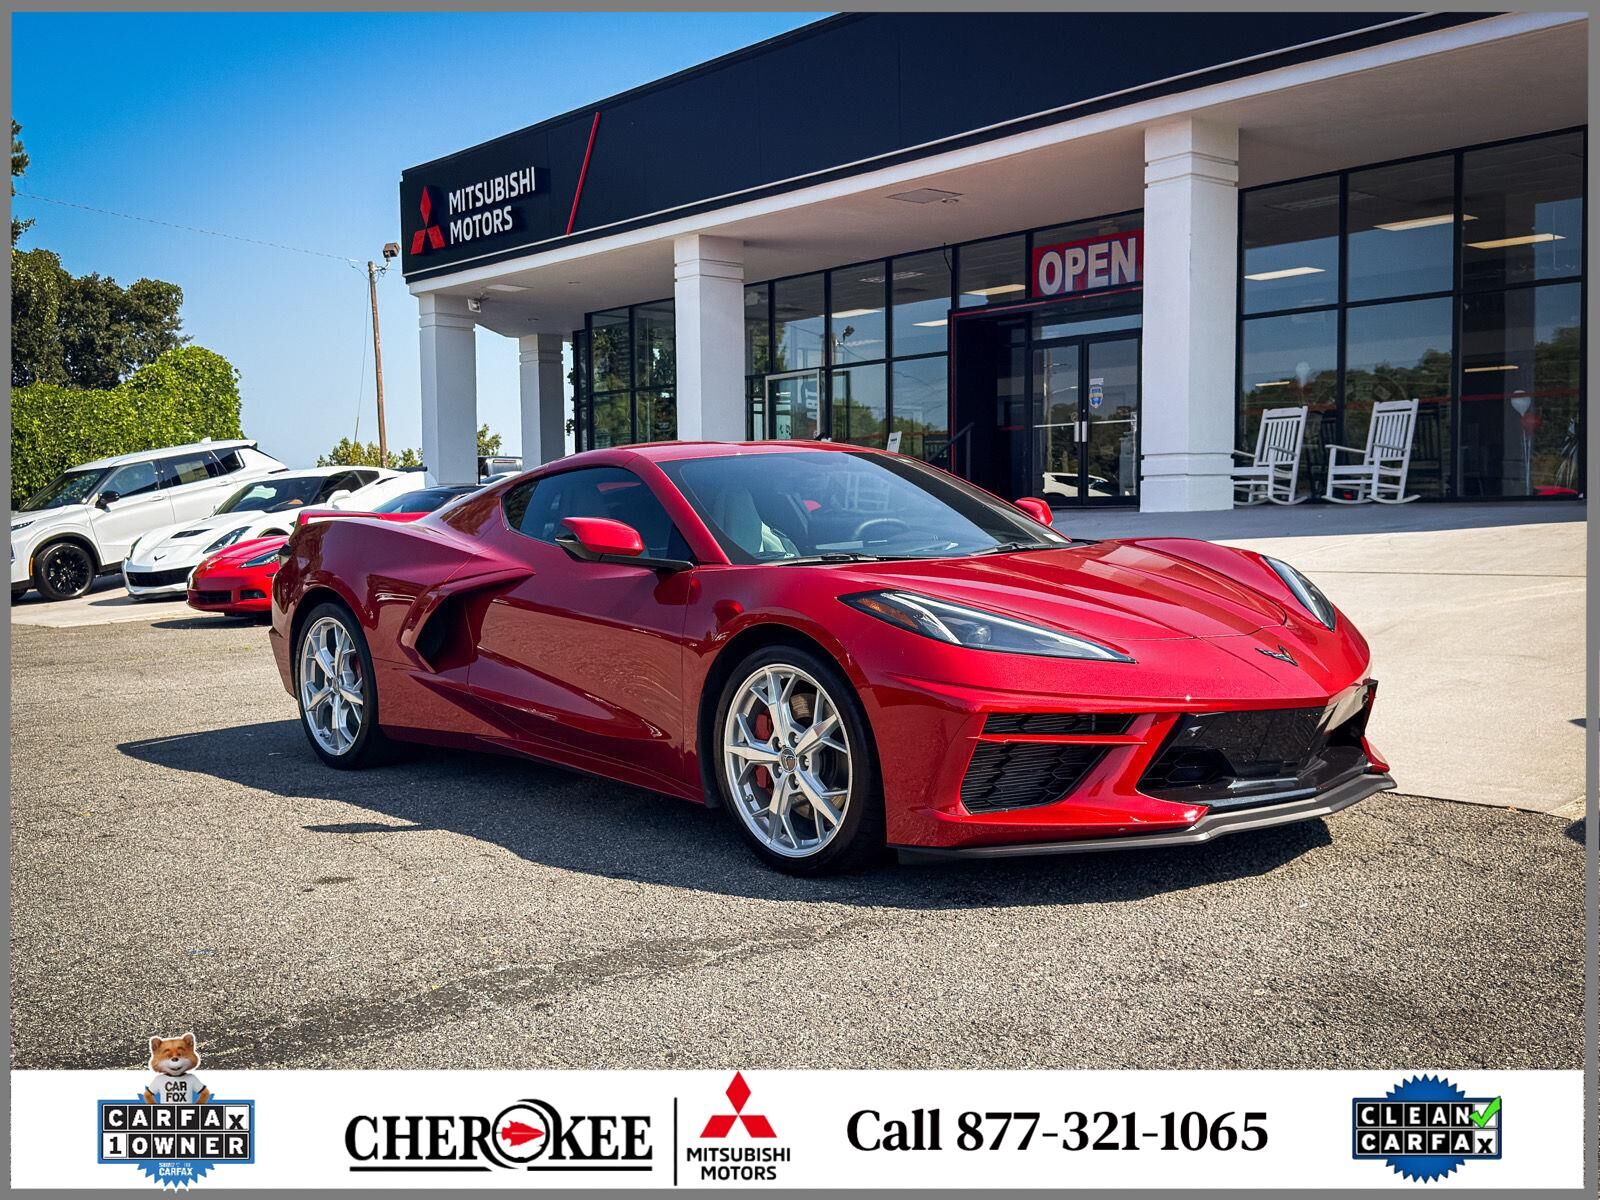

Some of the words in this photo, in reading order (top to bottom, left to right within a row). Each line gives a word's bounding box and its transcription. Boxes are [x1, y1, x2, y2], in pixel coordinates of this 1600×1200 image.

[449, 166, 536, 215] MITSUBISHI
[450, 205, 513, 245] MOTORS
[1038, 237, 1136, 295] OPEN
